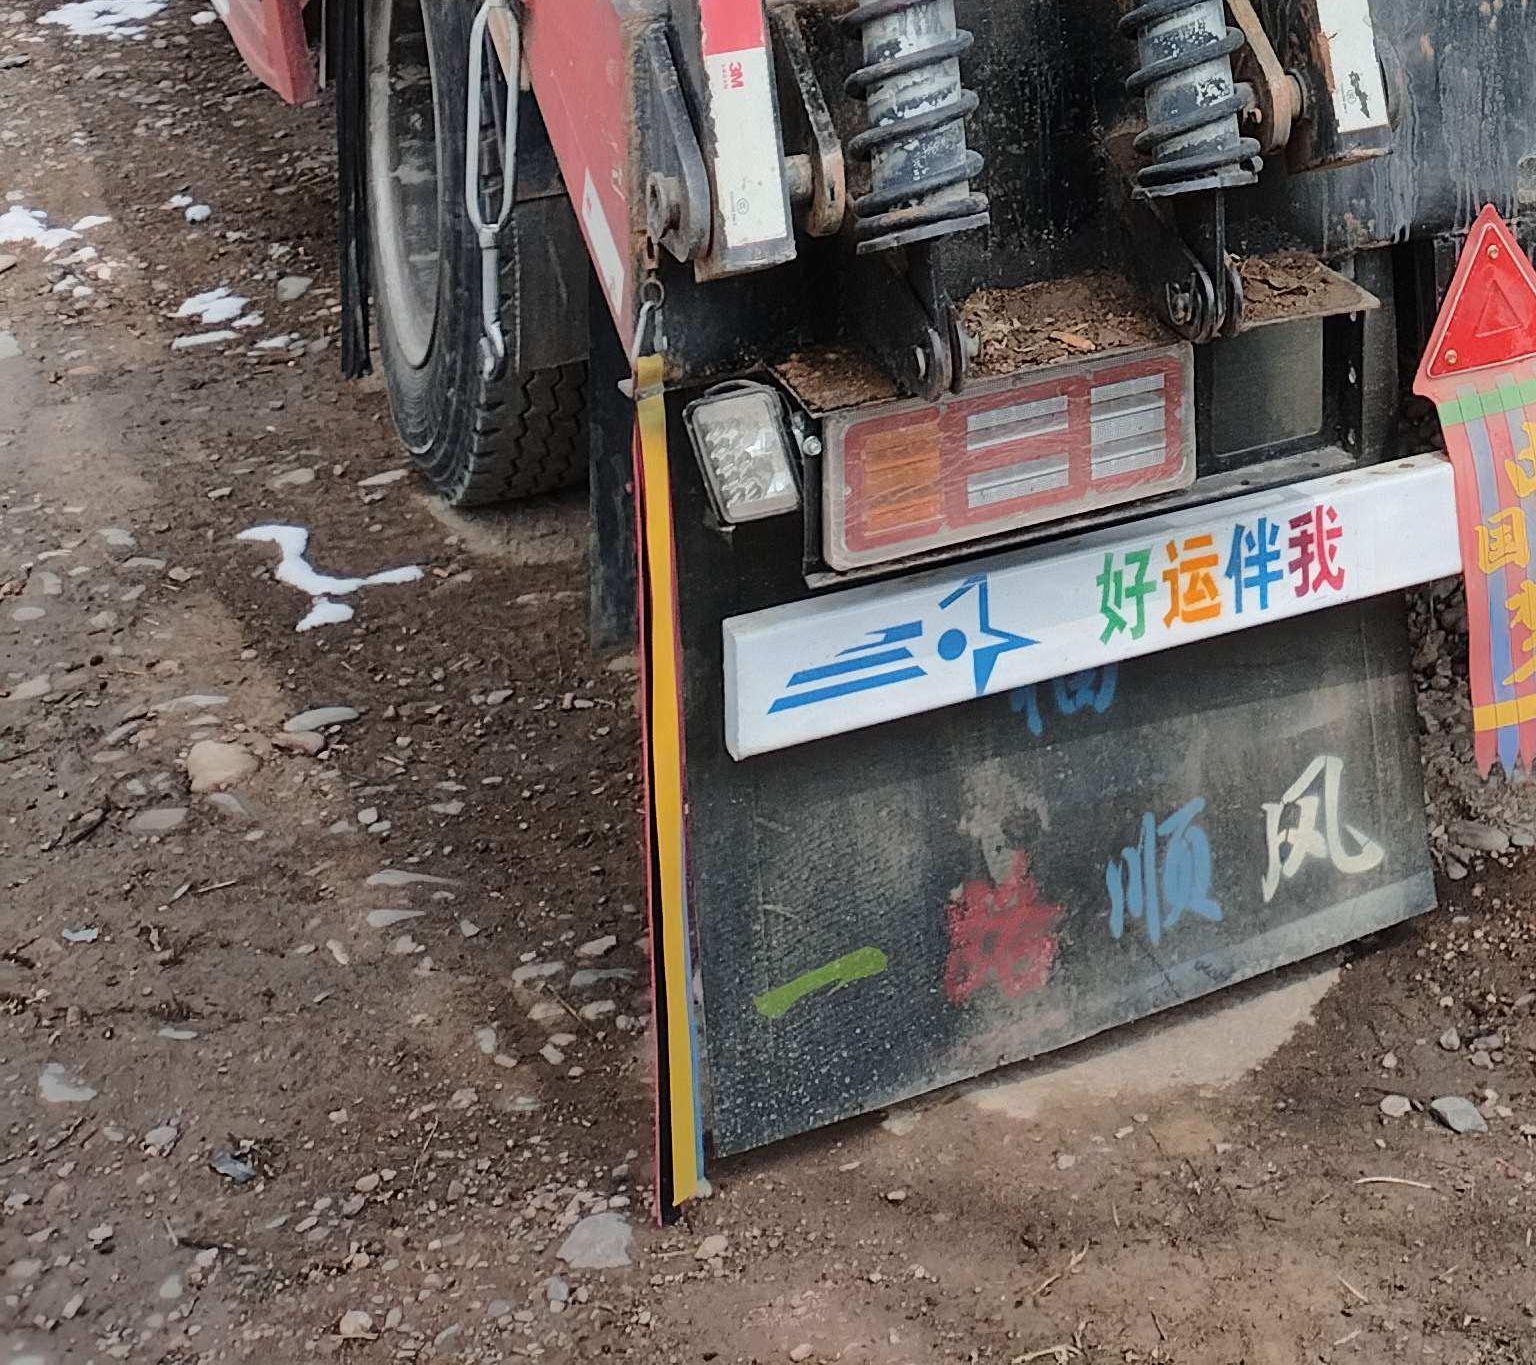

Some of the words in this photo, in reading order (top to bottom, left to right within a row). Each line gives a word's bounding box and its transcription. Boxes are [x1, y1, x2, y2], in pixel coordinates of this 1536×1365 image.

[729, 62, 744, 89] 3M
[1097, 503, 1346, 645] 好运伴我
